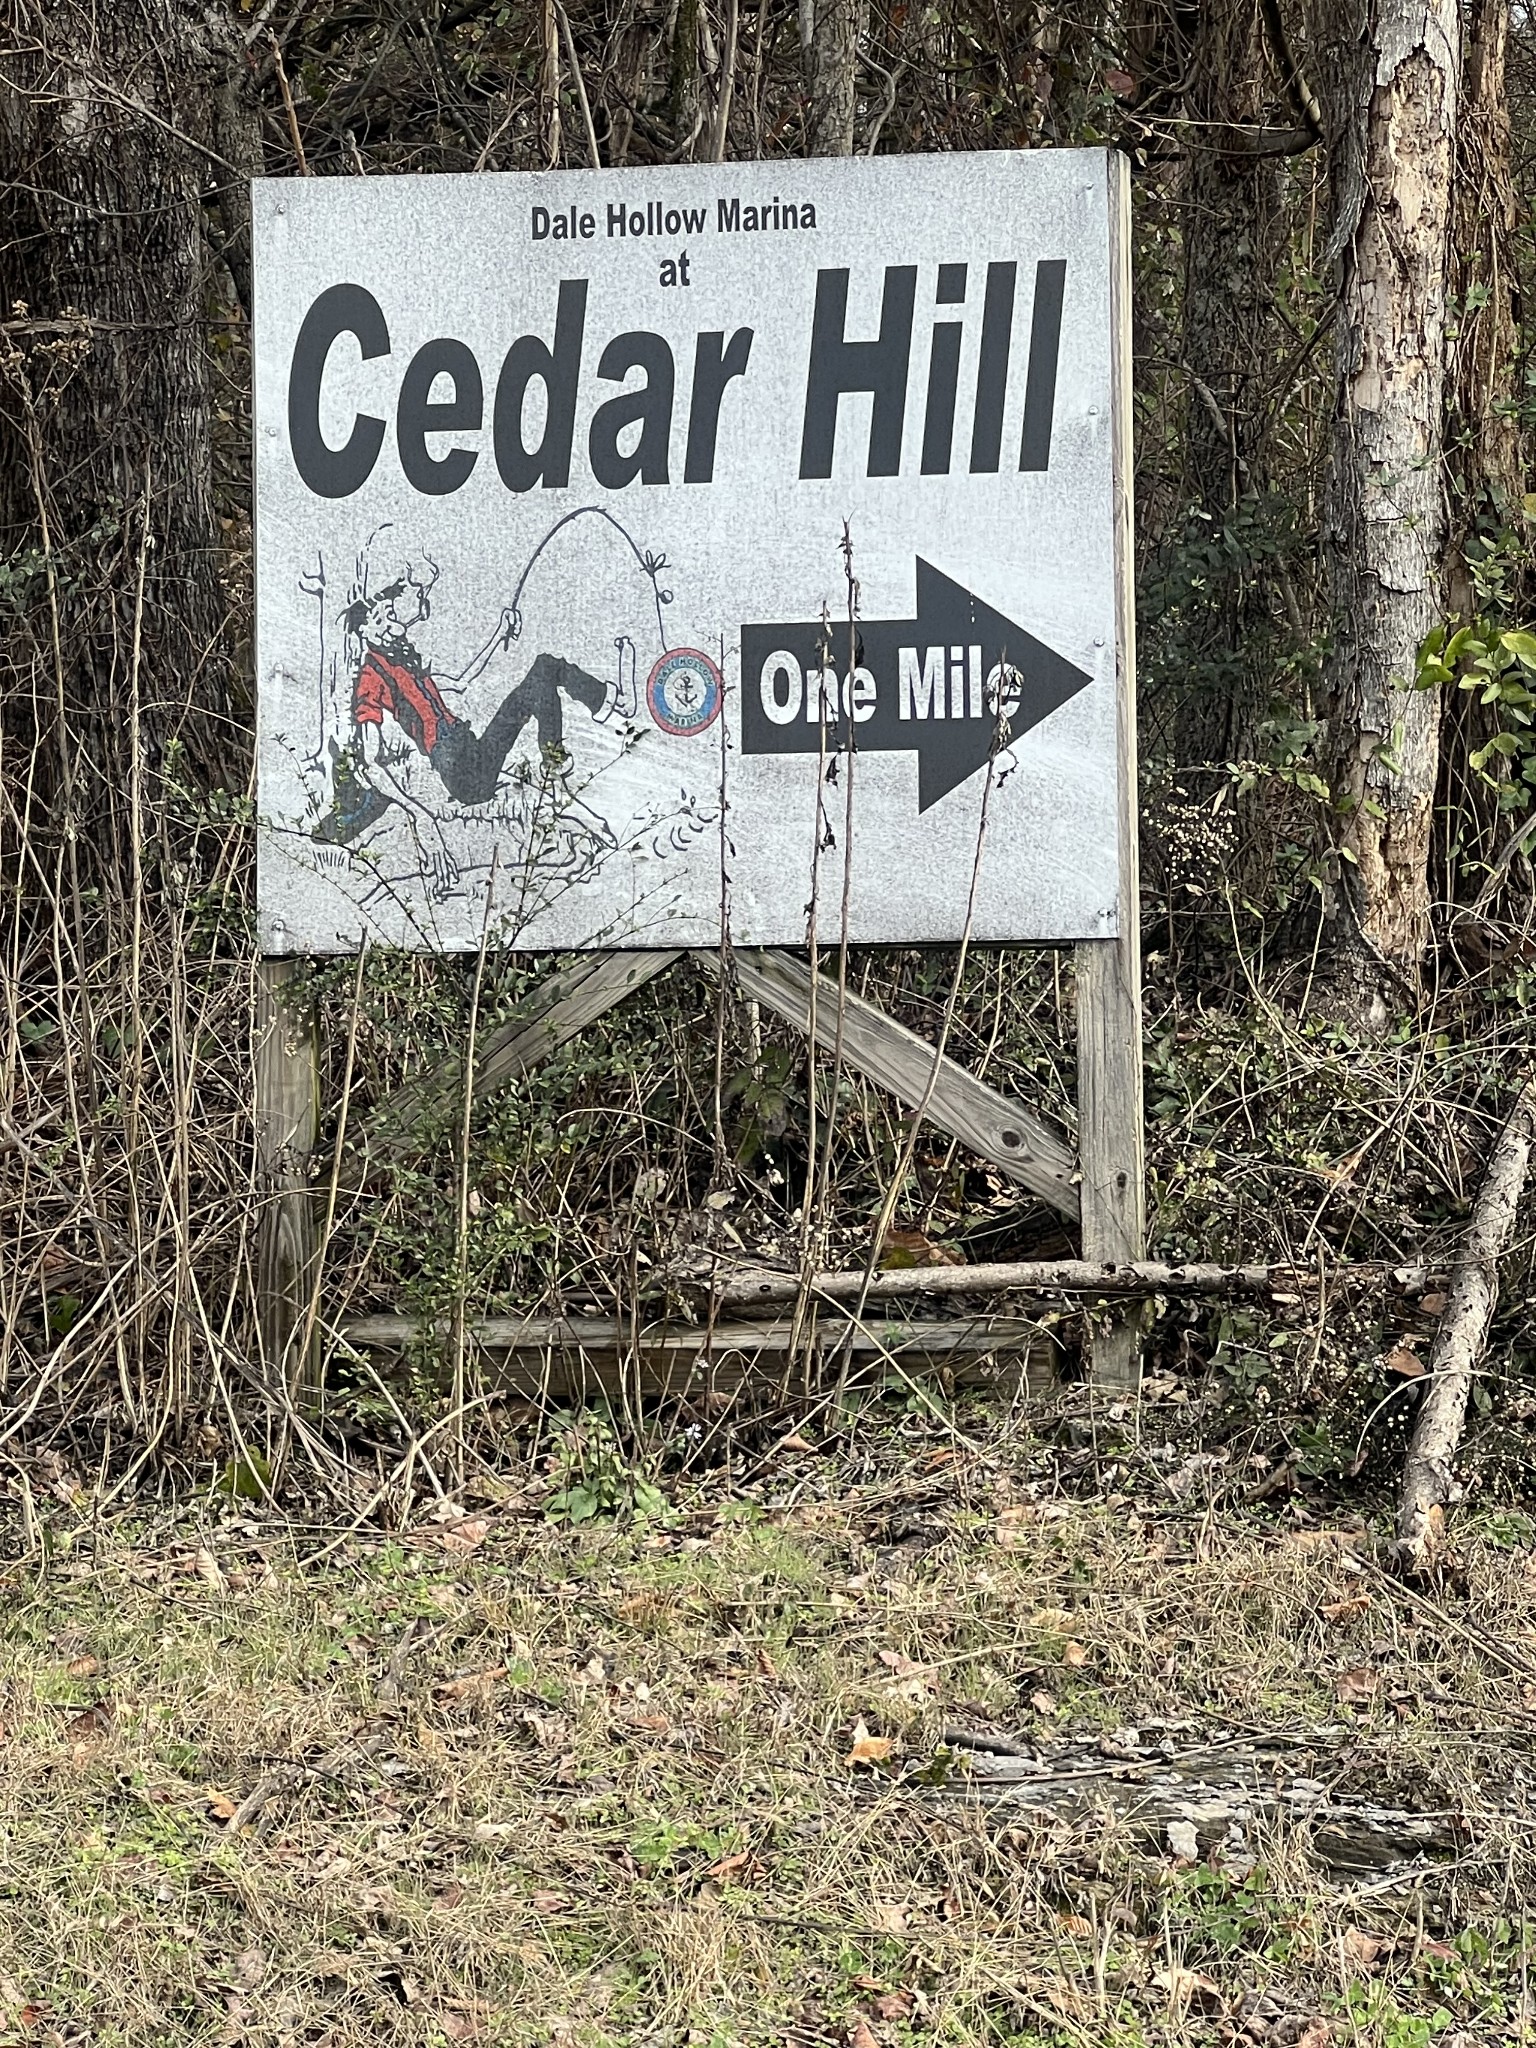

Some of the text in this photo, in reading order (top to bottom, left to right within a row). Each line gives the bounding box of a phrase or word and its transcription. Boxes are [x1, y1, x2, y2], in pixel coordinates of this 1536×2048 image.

[532, 196, 816, 240] Dale Hollow Marina
[659, 249, 690, 287] at
[288, 260, 1067, 499] Cedar Hill
[760, 645, 1022, 725] One Mile
[667, 713, 703, 726] MARINA
